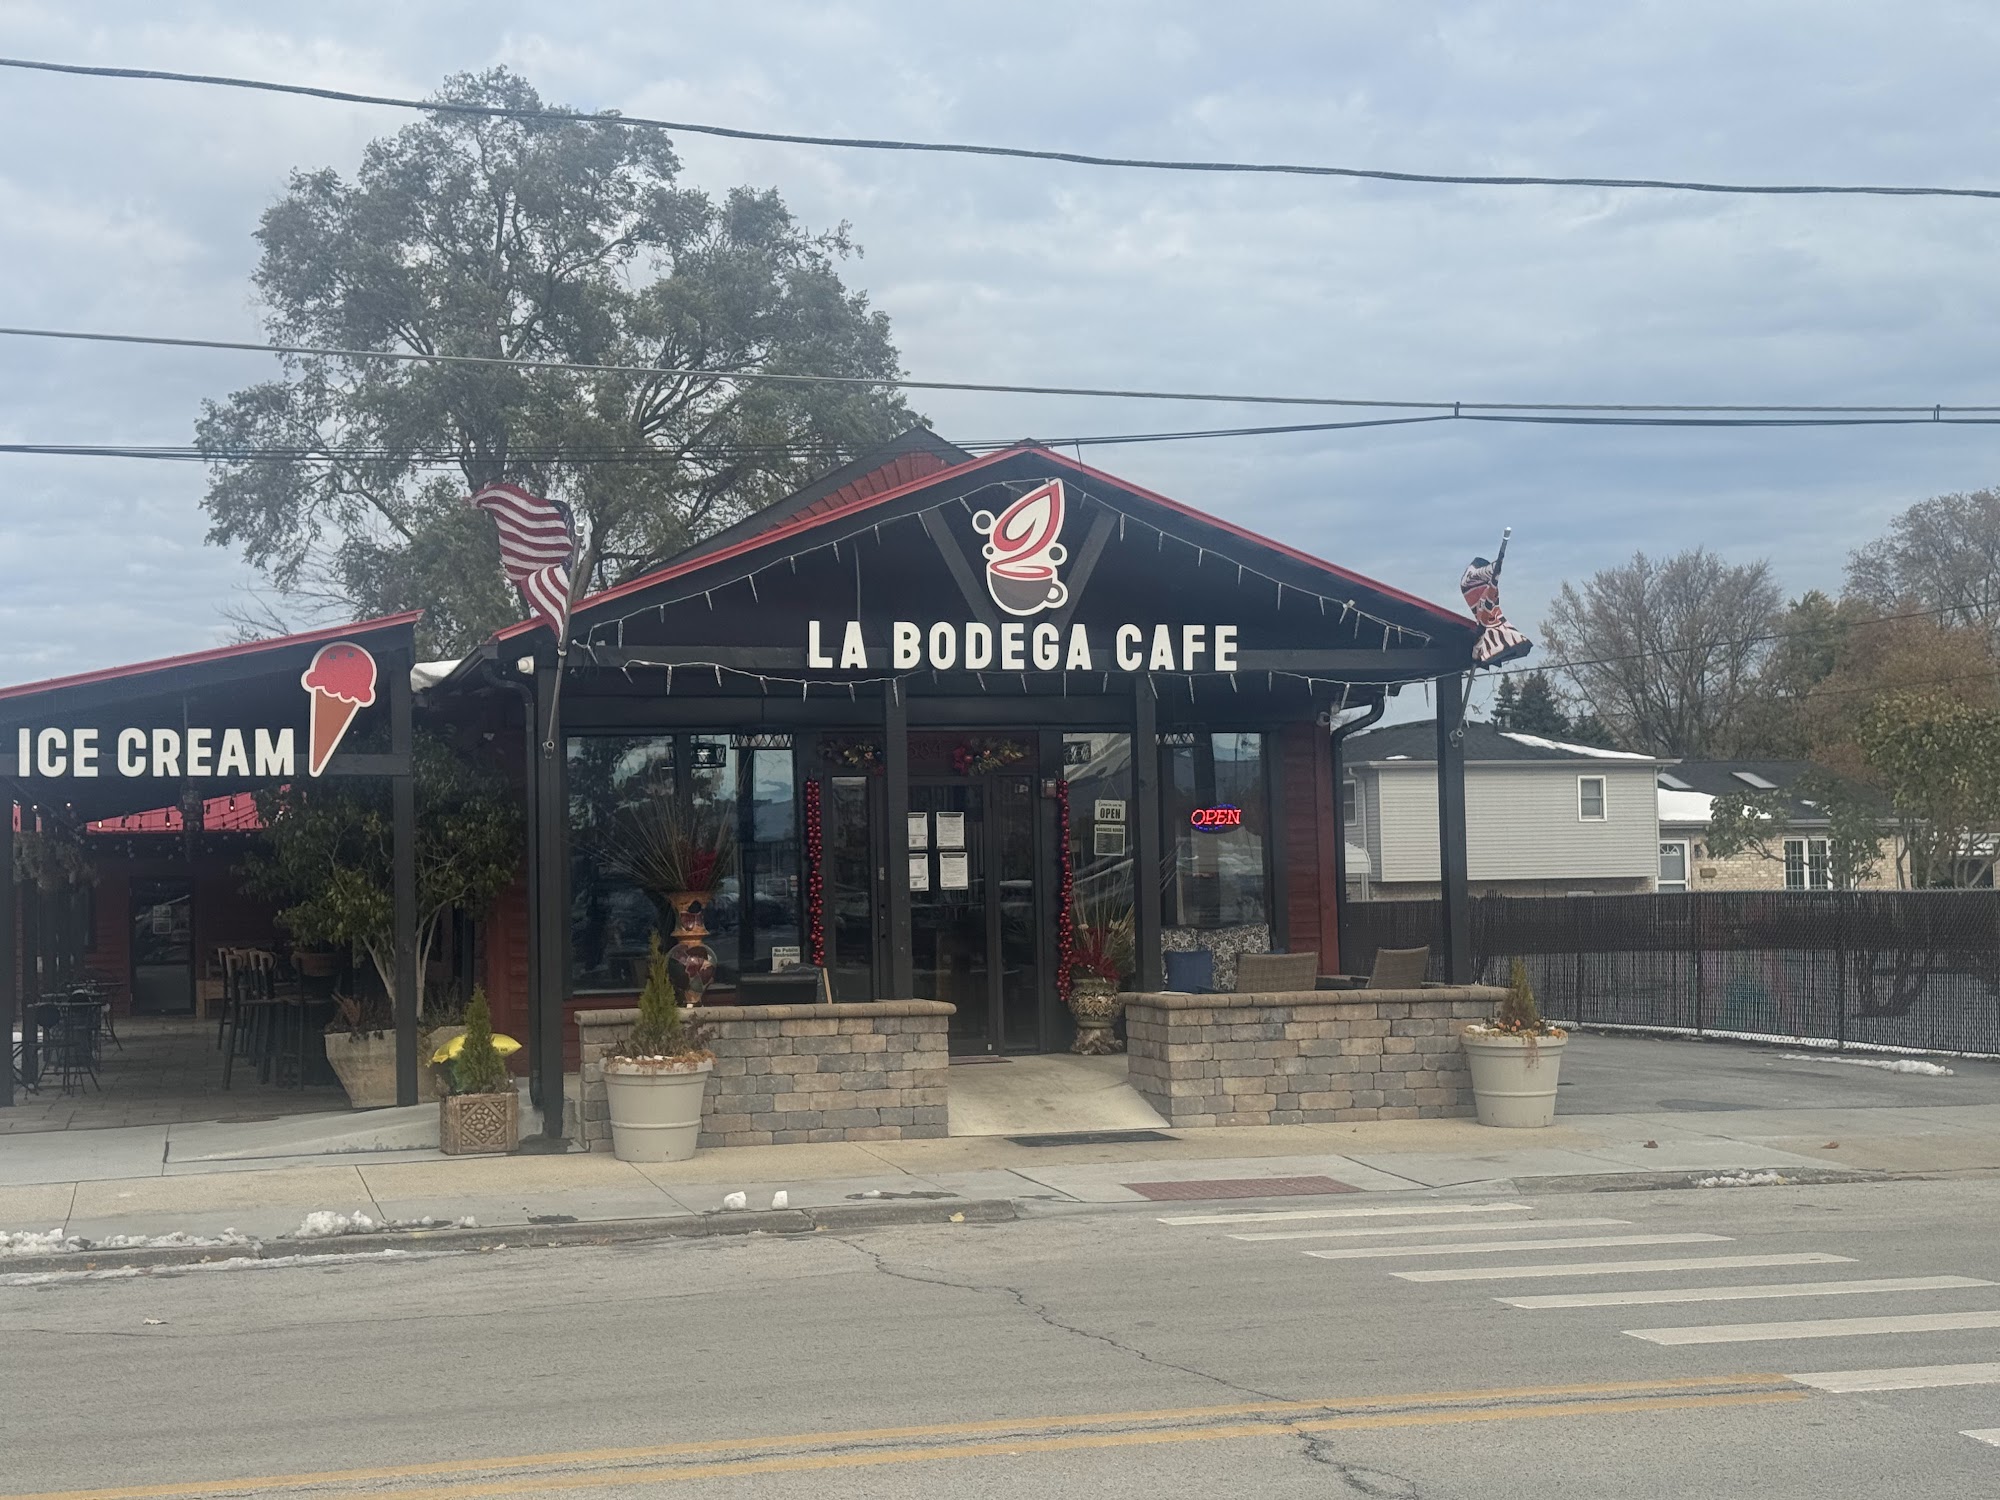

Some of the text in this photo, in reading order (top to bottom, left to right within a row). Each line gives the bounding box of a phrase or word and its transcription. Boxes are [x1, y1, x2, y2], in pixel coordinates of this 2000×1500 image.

[808, 620, 1238, 671] LA BODEGA CAFE
[18, 727, 294, 777] ICE CREAM
[1100, 807, 1121, 819] OPEN
[1190, 808, 1242, 825] OPEN
